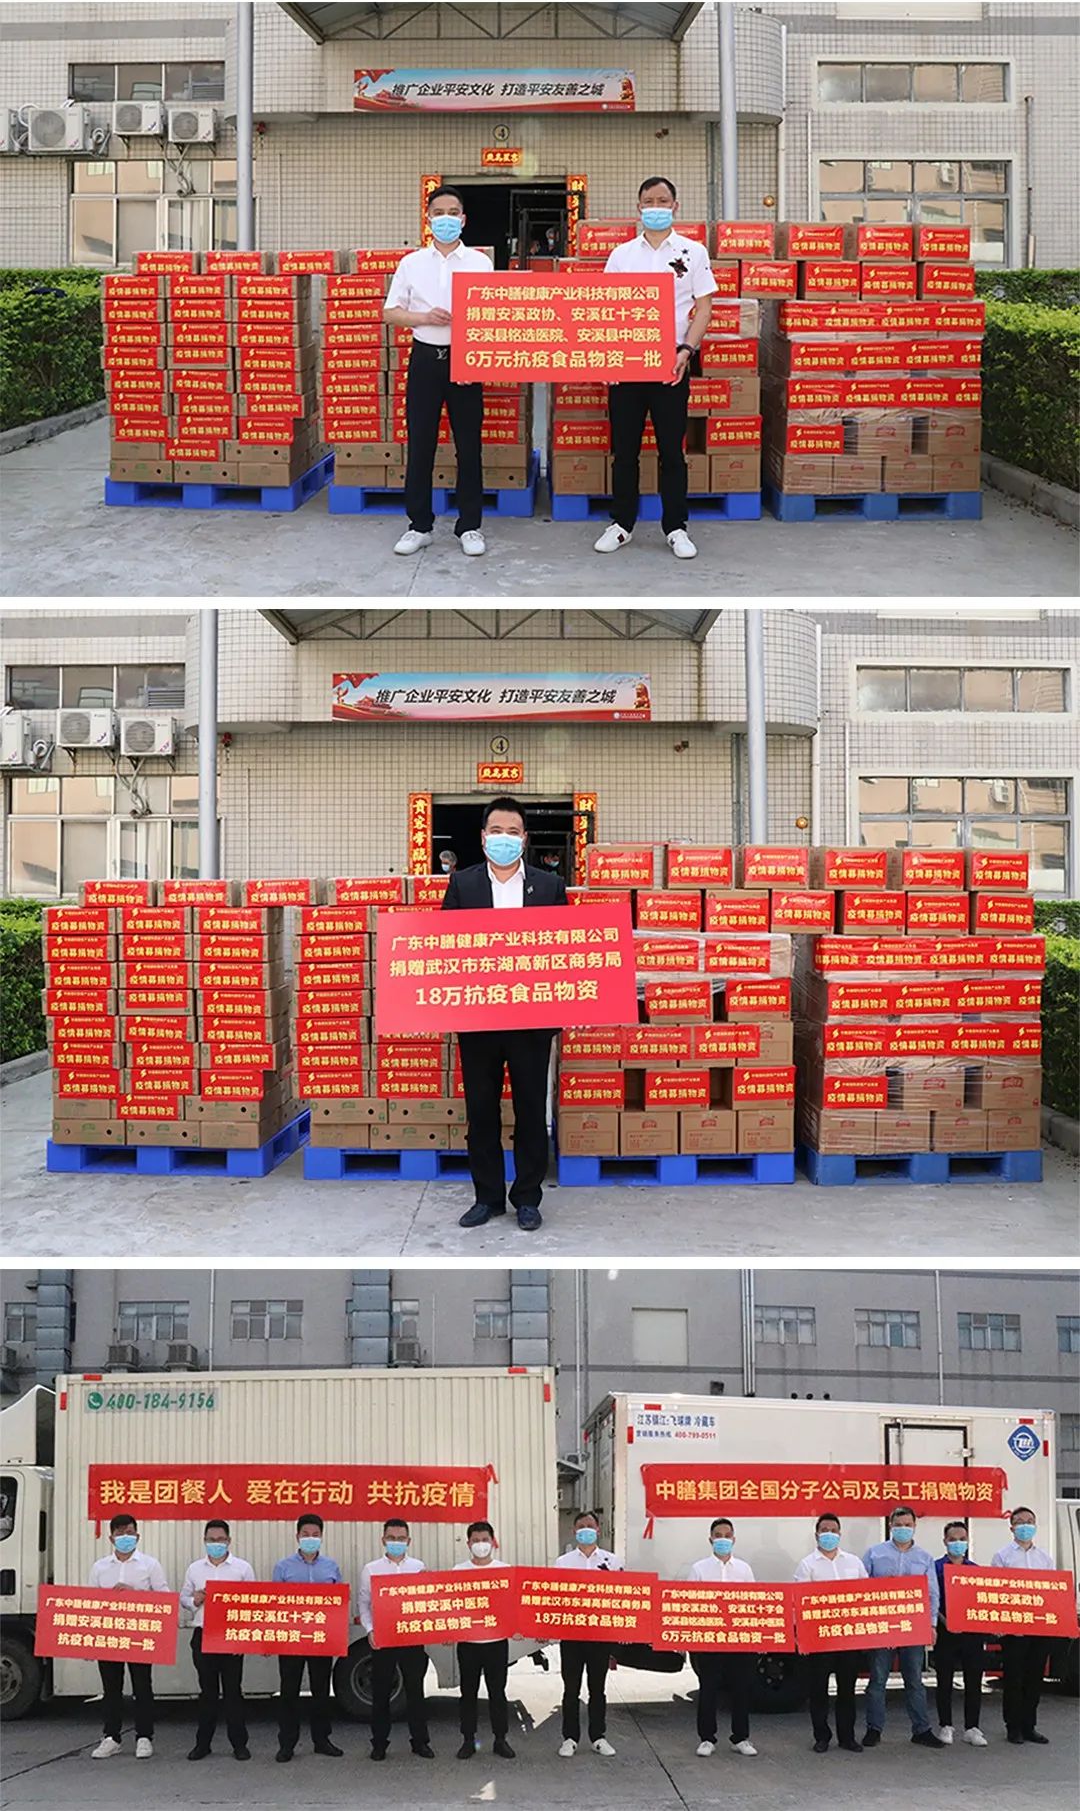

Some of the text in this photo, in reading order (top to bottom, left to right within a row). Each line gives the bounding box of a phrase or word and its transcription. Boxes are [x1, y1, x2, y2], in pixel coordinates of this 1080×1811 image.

[392, 83, 604, 97] 推广企业平安文化 打造平安友善之城
[467, 286, 659, 301] 广东中膳健康产业科技有限公司
[465, 350, 662, 369] 6万元抗疫食品物资一批
[375, 688, 616, 704] 推广企业平安文化 打造平安友善之城
[391, 928, 620, 952] 广东中膳健康产业科技有限公司
[390, 951, 621, 978] 捐赠武汉市东湖高新区商务局
[416, 980, 598, 1007] 18万抗疫食品物资
[105, 1391, 215, 1410] 400-184-9156
[100, 1479, 475, 1508] 我是团餐人 爱在行动 共抗疫情
[656, 1479, 993, 1502] 中膳集团全国分子公司及员工捐赠物资
[401, 1596, 489, 1614] 捐赠安溪中医院
[977, 1592, 1044, 1606] 捐赠安溪政协
[227, 1609, 326, 1624] 捐赠安溪红十字会
[397, 1615, 497, 1633] 抗疫食品物资一批
[535, 1613, 636, 1628] 18万抗疫食品物资
[967, 1609, 1057, 1624] 抗疫食品物资一批
[225, 1628, 326, 1643] 抗疫食品物资一批
[818, 1620, 912, 1637] 抗疫食品物资一批
[58, 1632, 155, 1651] 抗疫食品物资一批
[660, 1631, 786, 1644] 6万元抗疫食品物资一批
